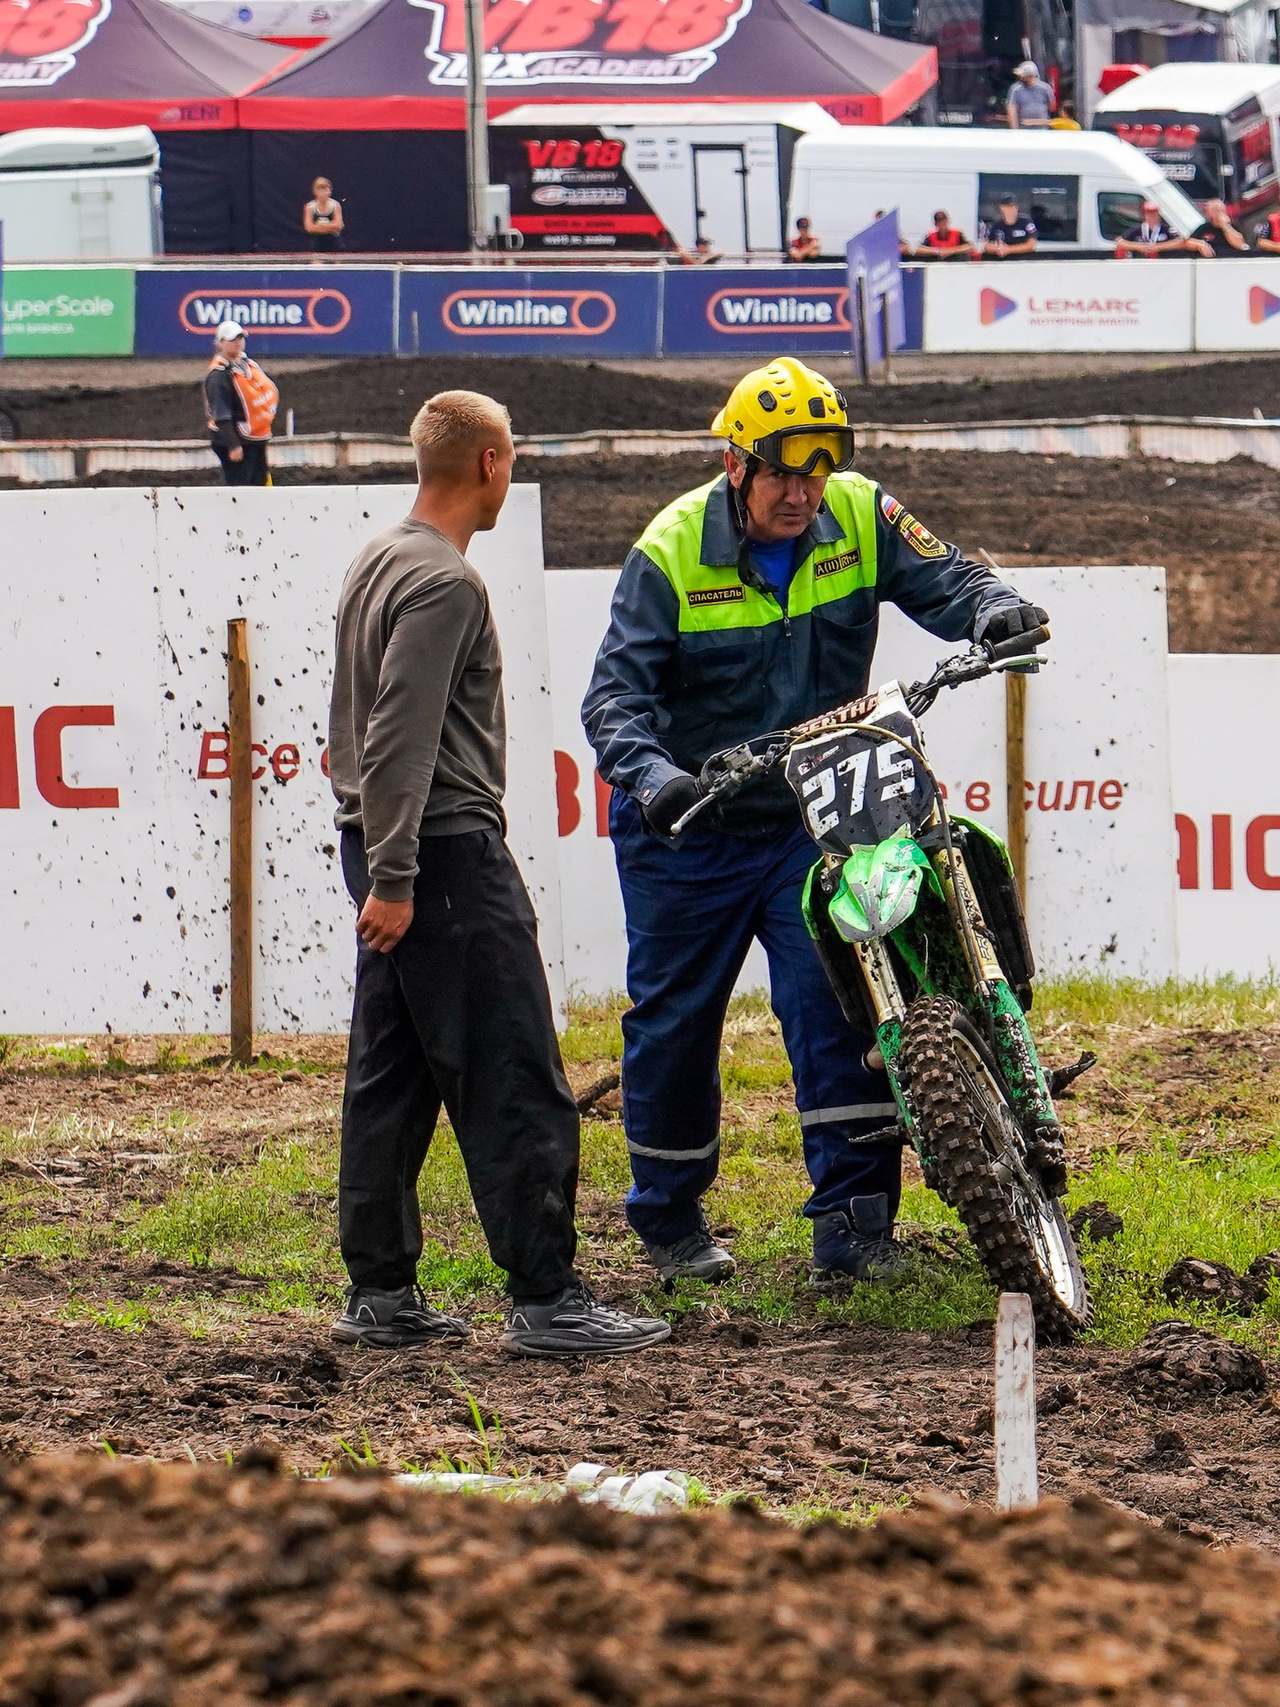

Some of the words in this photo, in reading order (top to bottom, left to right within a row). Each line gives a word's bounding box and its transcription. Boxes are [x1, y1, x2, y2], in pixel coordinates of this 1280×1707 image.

[524, 139, 625, 168] VB18
[194, 299, 303, 324] Winline
[457, 300, 568, 325] Winline
[722, 298, 833, 324] Winline
[1027, 296, 1141, 313] LEMARC
[689, 589, 742, 602] СПАСАТЕЛЬ
[802, 736, 916, 840] 275
